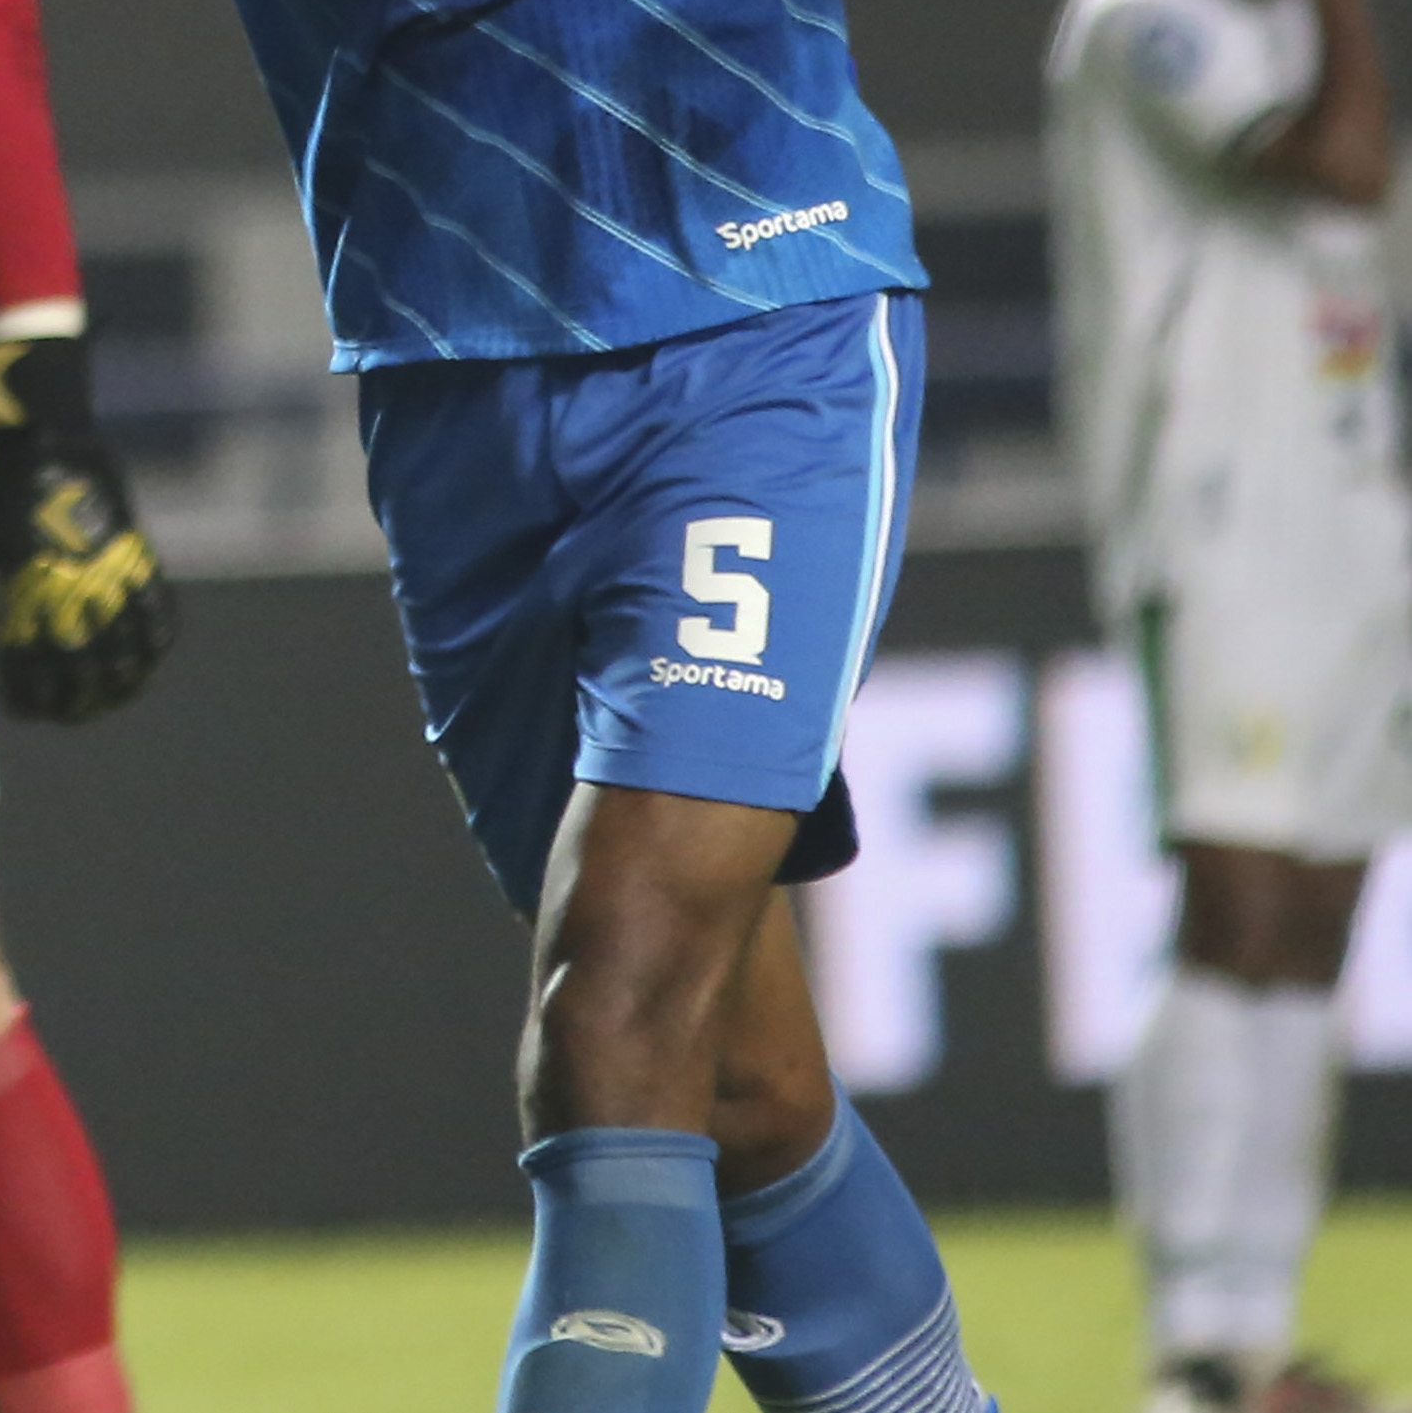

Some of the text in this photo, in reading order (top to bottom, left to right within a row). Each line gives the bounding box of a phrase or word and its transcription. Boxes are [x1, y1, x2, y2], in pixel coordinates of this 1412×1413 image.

[715, 199, 849, 251] Sportama
[677, 516, 773, 666] 5
[649, 656, 786, 701] Sportama
